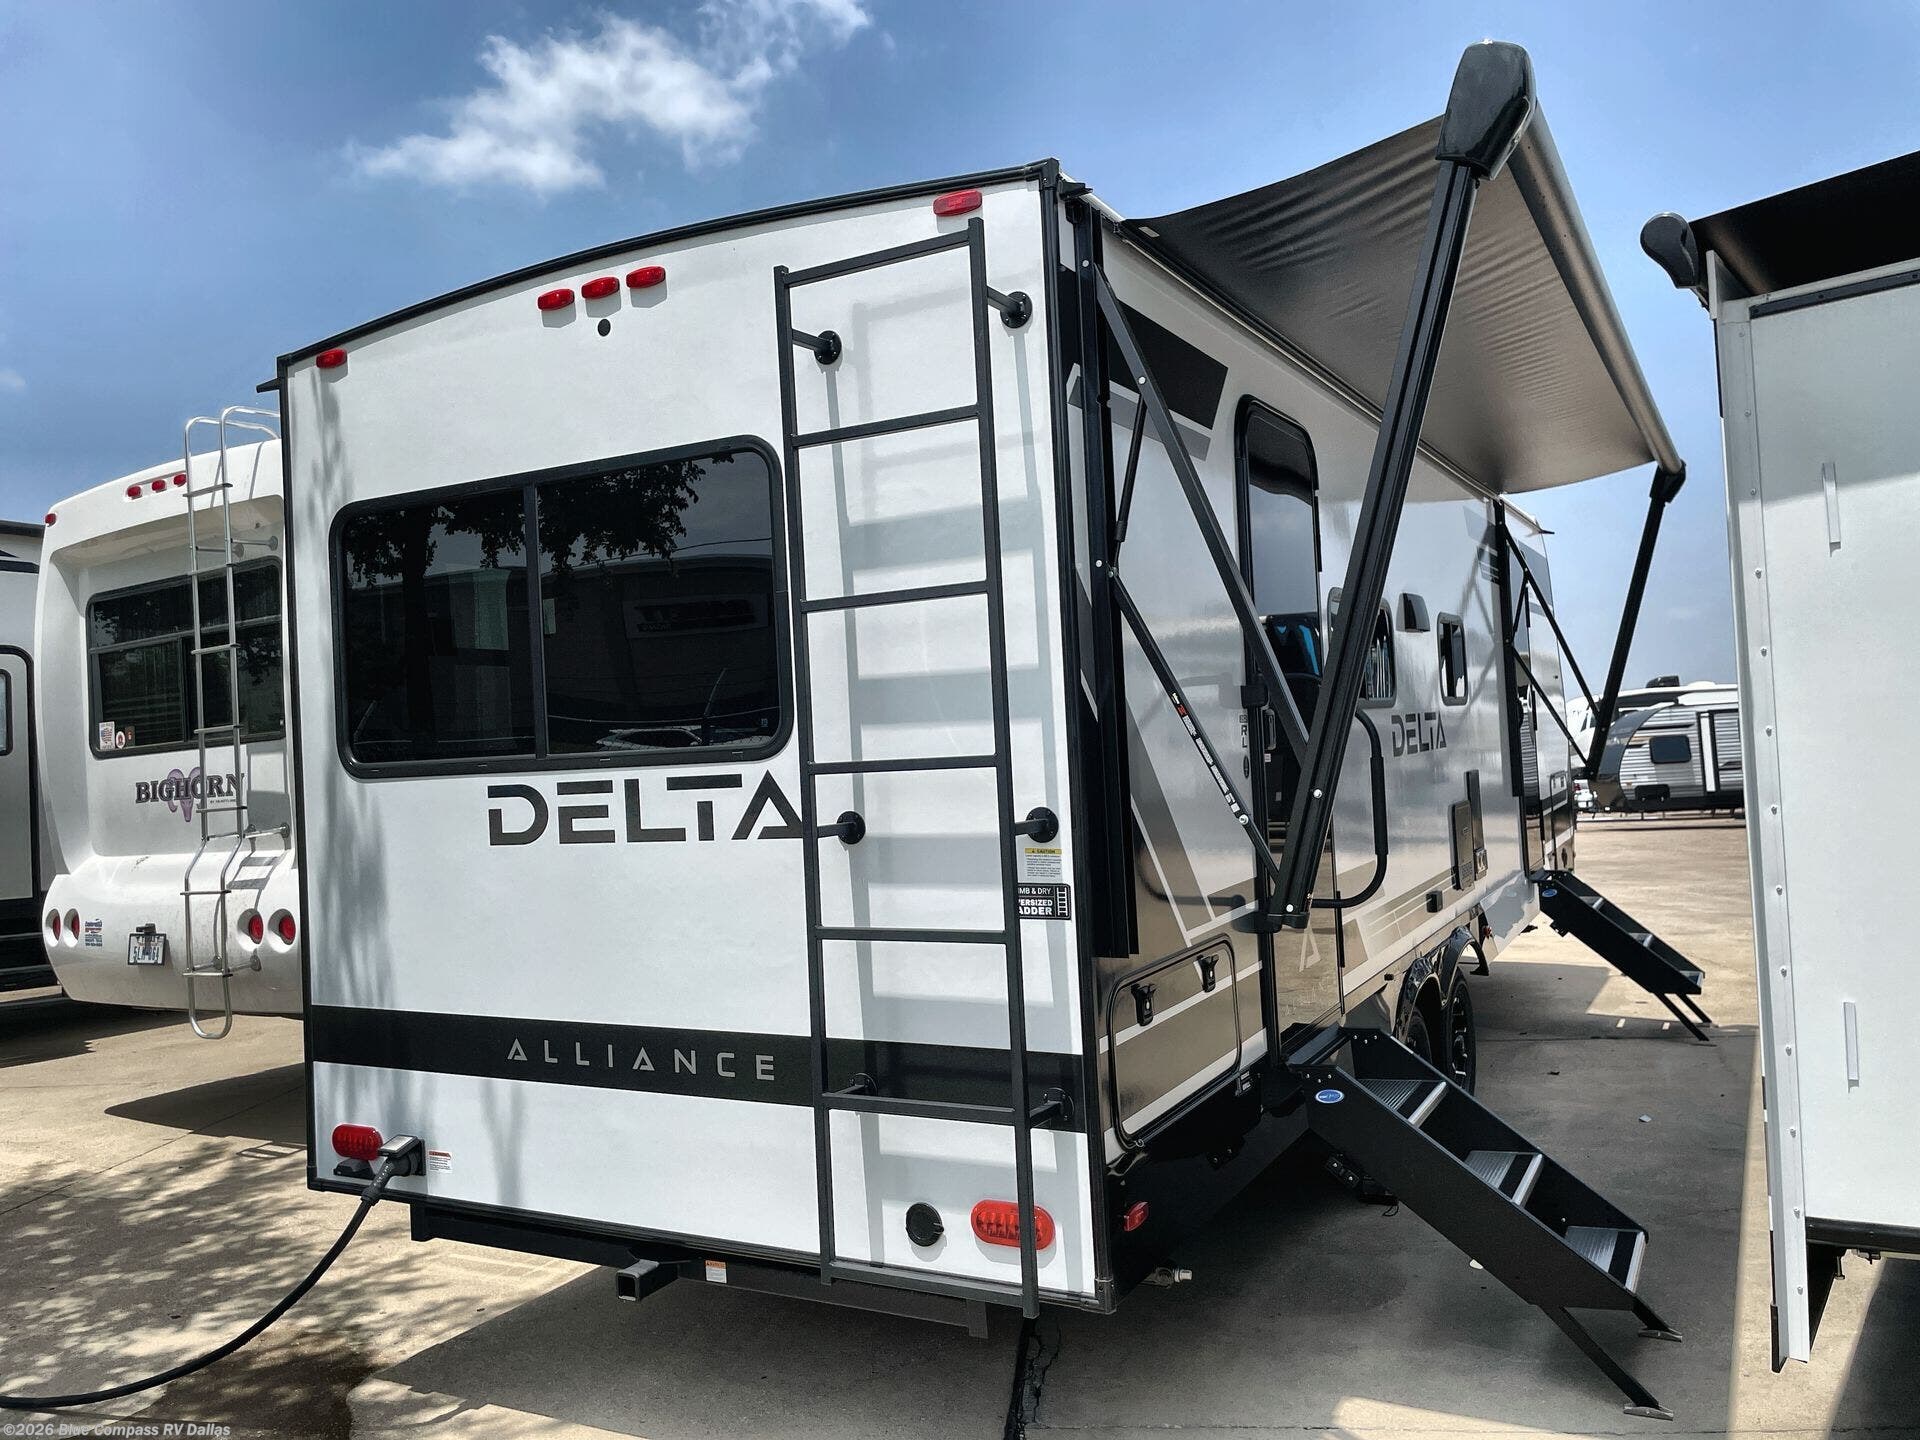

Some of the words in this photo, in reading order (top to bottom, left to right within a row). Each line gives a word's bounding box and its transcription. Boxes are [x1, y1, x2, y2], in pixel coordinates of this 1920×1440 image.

[1391, 711, 1447, 757] DELTA
[135, 773, 244, 804] BIGHORN
[488, 769, 804, 846] DELTA
[1018, 899, 1053, 907] ERSIZED
[1038, 887, 1051, 895] DRY
[507, 1038, 775, 1081] ALLIANCE
